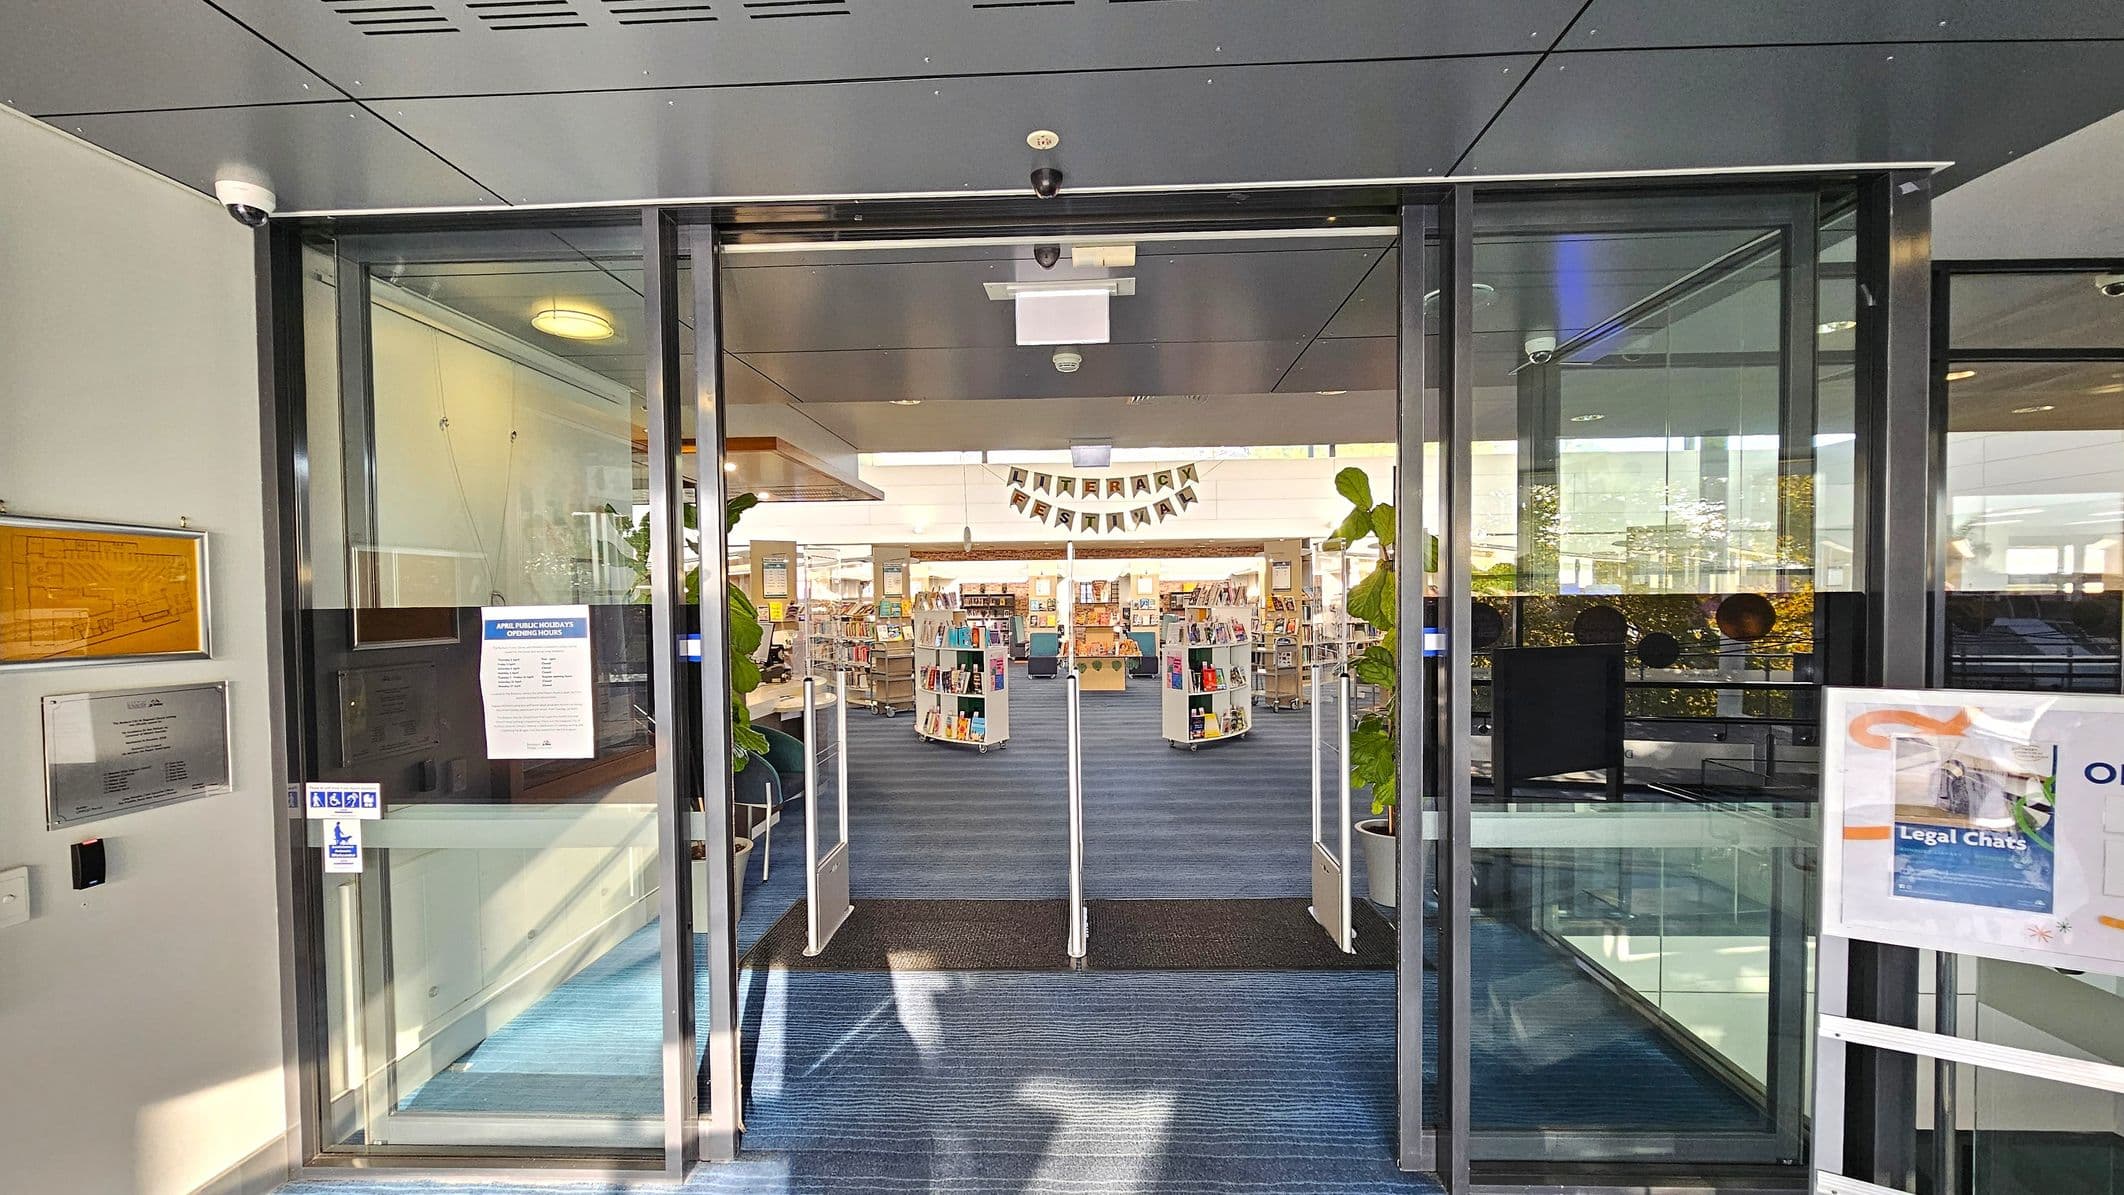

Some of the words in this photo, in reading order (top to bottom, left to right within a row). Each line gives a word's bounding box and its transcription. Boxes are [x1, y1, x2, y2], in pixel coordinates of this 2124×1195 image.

[1012, 467, 1192, 492] LITERACY
[1012, 492, 1193, 527] FESTIVAL
[496, 622, 514, 630] APRIL
[1900, 826, 1957, 846] Legal
[1963, 831, 2027, 851] Chats
